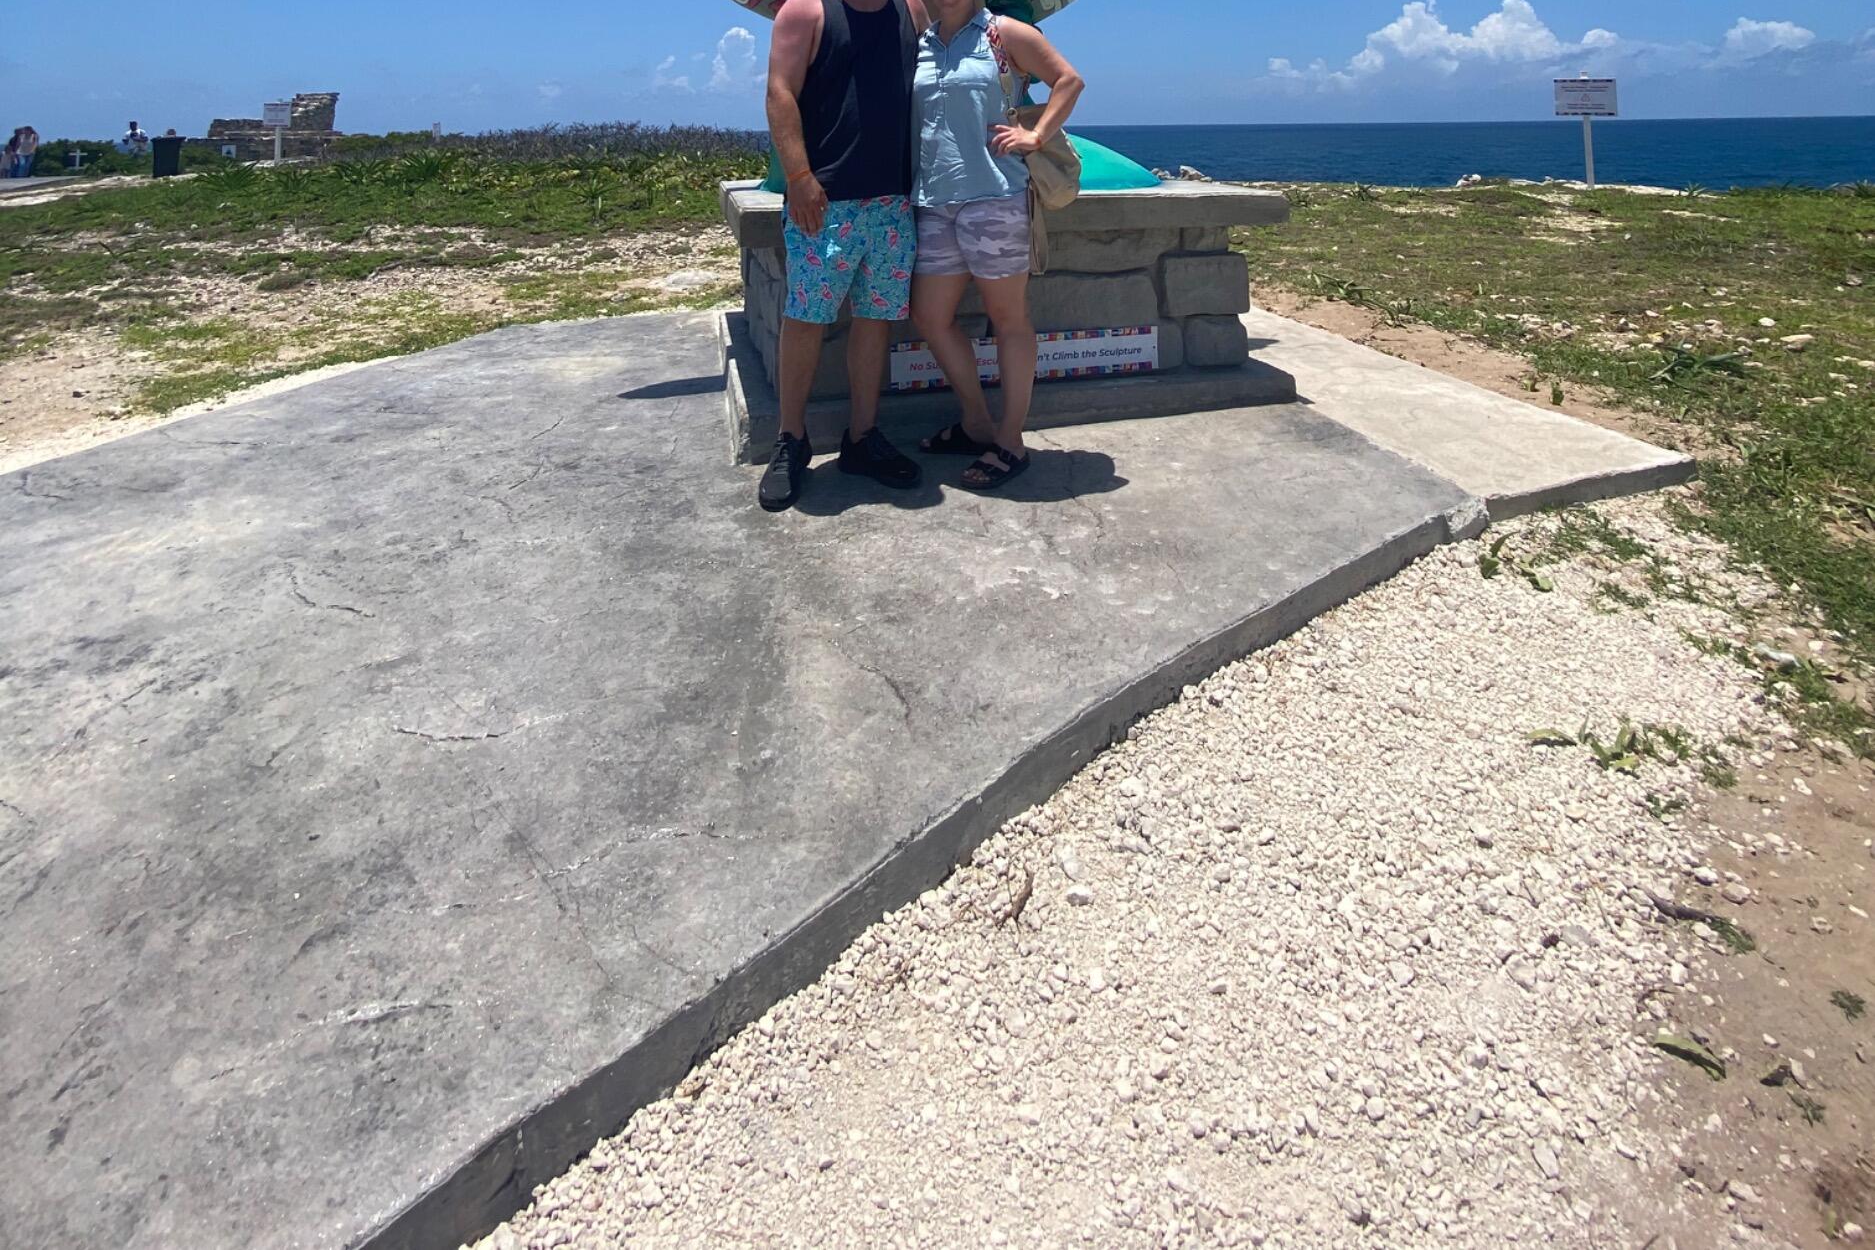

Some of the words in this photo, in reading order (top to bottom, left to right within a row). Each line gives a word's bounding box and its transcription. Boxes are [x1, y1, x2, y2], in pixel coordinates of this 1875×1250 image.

[910, 362, 923, 371] No
[976, 358, 999, 367] Escu
[1052, 350, 1080, 361] Climb
[1082, 349, 1097, 359] the
[1099, 346, 1142, 357] Sculpture
